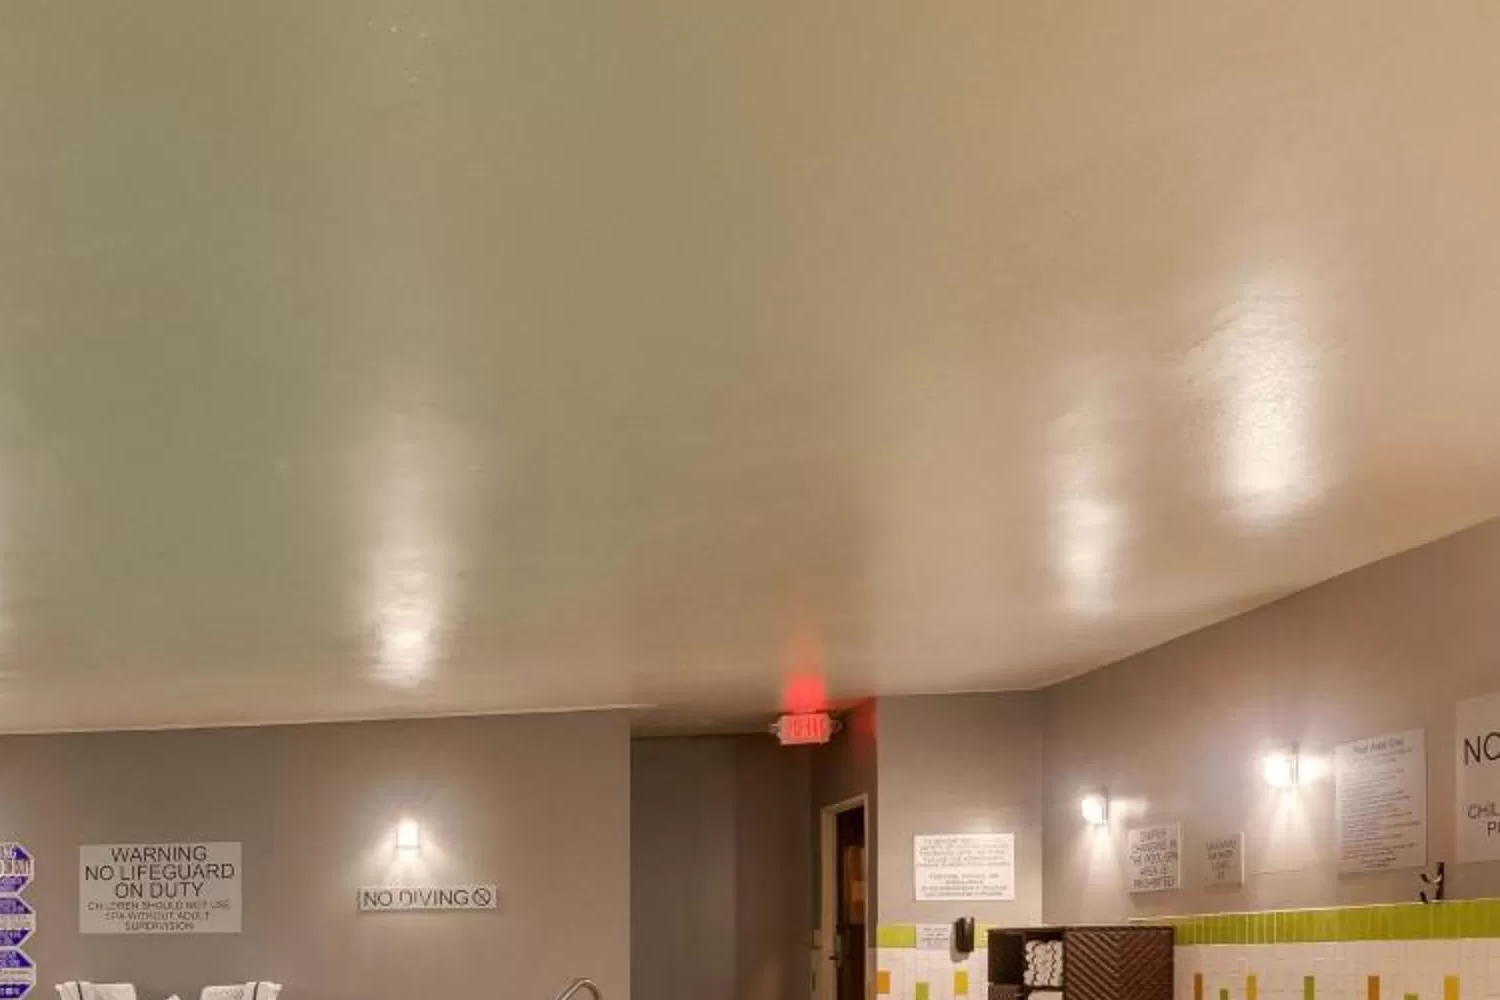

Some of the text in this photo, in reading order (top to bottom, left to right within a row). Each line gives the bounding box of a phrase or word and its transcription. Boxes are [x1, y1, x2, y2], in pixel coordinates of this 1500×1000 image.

[111, 845, 207, 862] WARNING
[85, 863, 235, 881] NO LIFEGUARD
[115, 881, 204, 899] ON DUTY
[363, 889, 469, 907] NO DIVING
